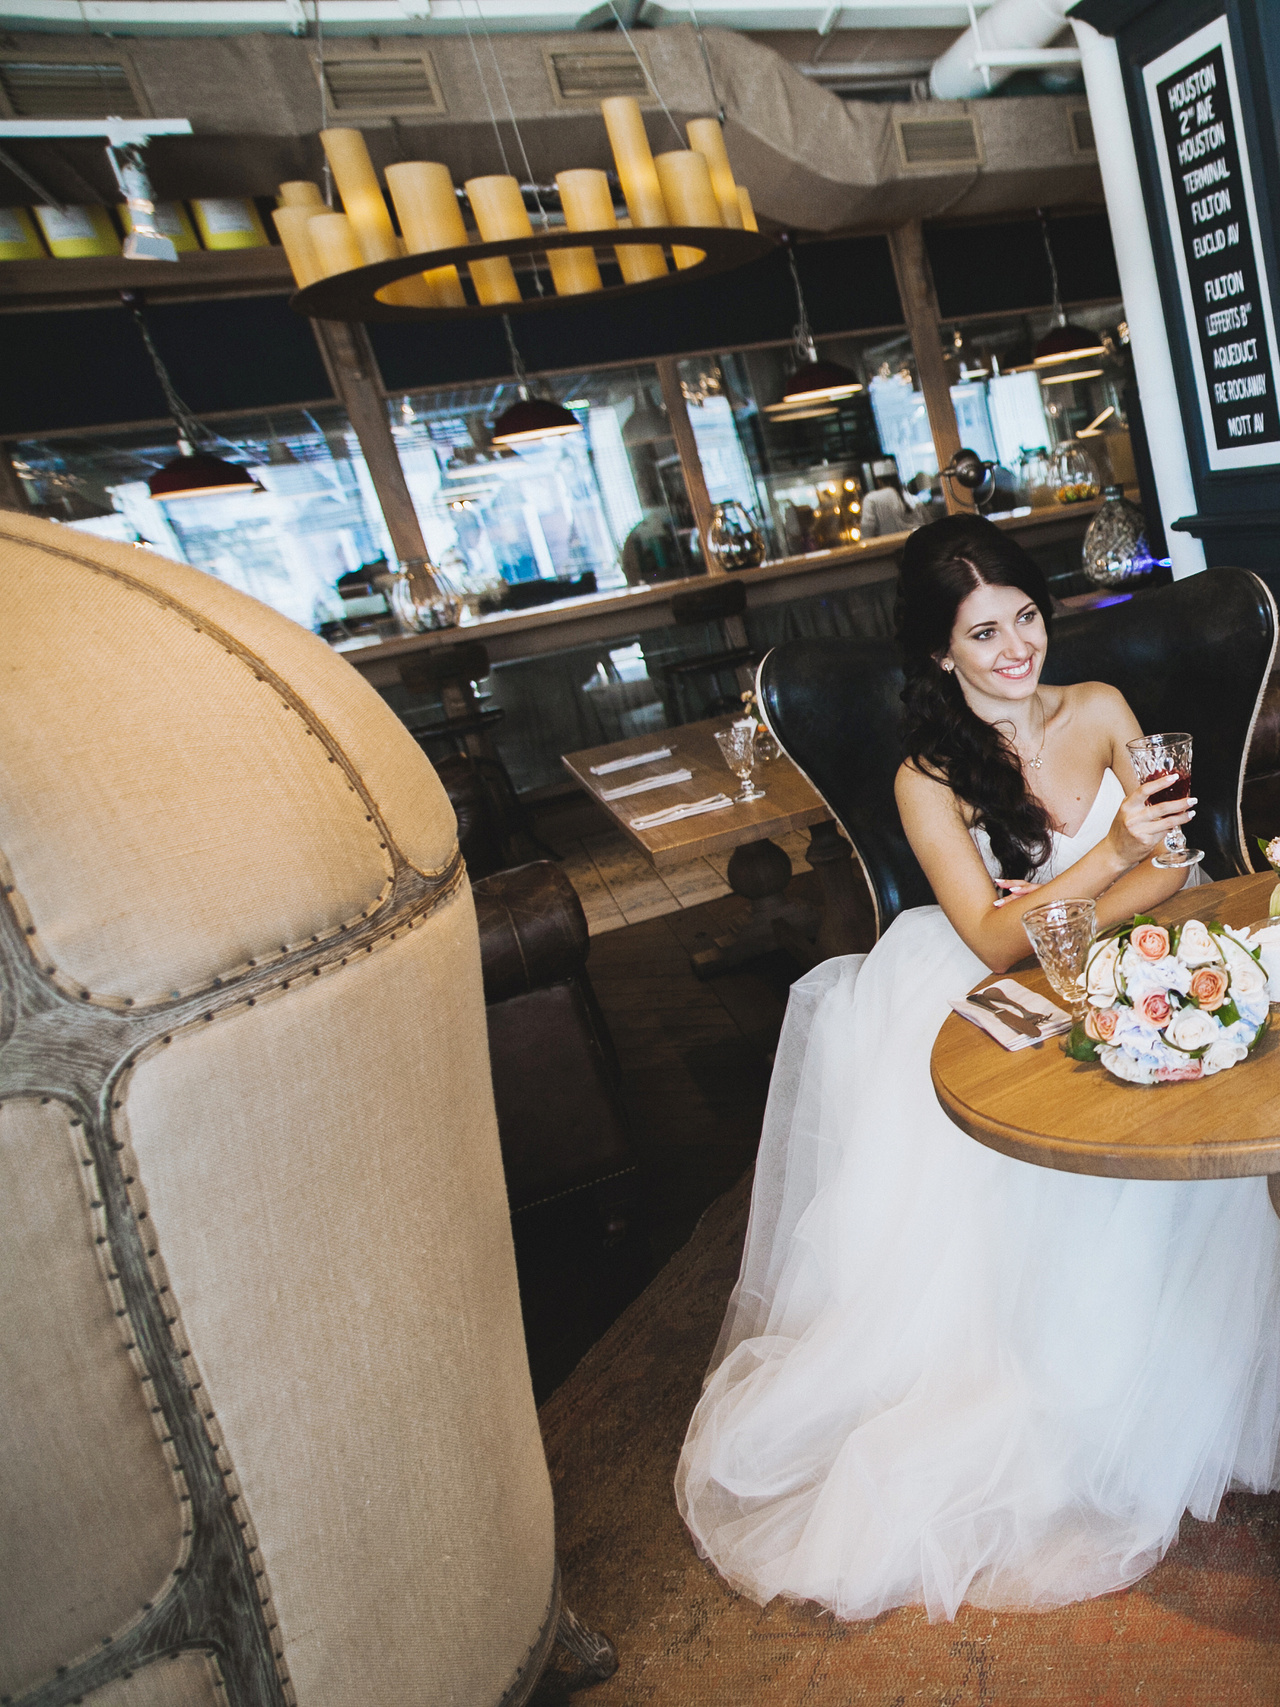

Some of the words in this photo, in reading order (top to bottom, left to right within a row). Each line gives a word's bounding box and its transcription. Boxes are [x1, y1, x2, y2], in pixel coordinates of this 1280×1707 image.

[1167, 62, 1217, 112] HOUSTON
[1196, 94, 1216, 127] AVE
[1177, 120, 1226, 166] HOUSTON
[1182, 156, 1231, 195] TERMINAL
[1191, 187, 1232, 225] FULTON
[1193, 228, 1226, 259] EUCLID
[1227, 222, 1239, 247] AV
[1204, 270, 1245, 303] FULTON
[1205, 306, 1241, 337] LEFFERTS
[1213, 338, 1258, 369] AQUEDUCT
[1227, 373, 1267, 401] ROCKAWAY
[1227, 414, 1252, 437] MOTT
[1254, 412, 1264, 434] AV
